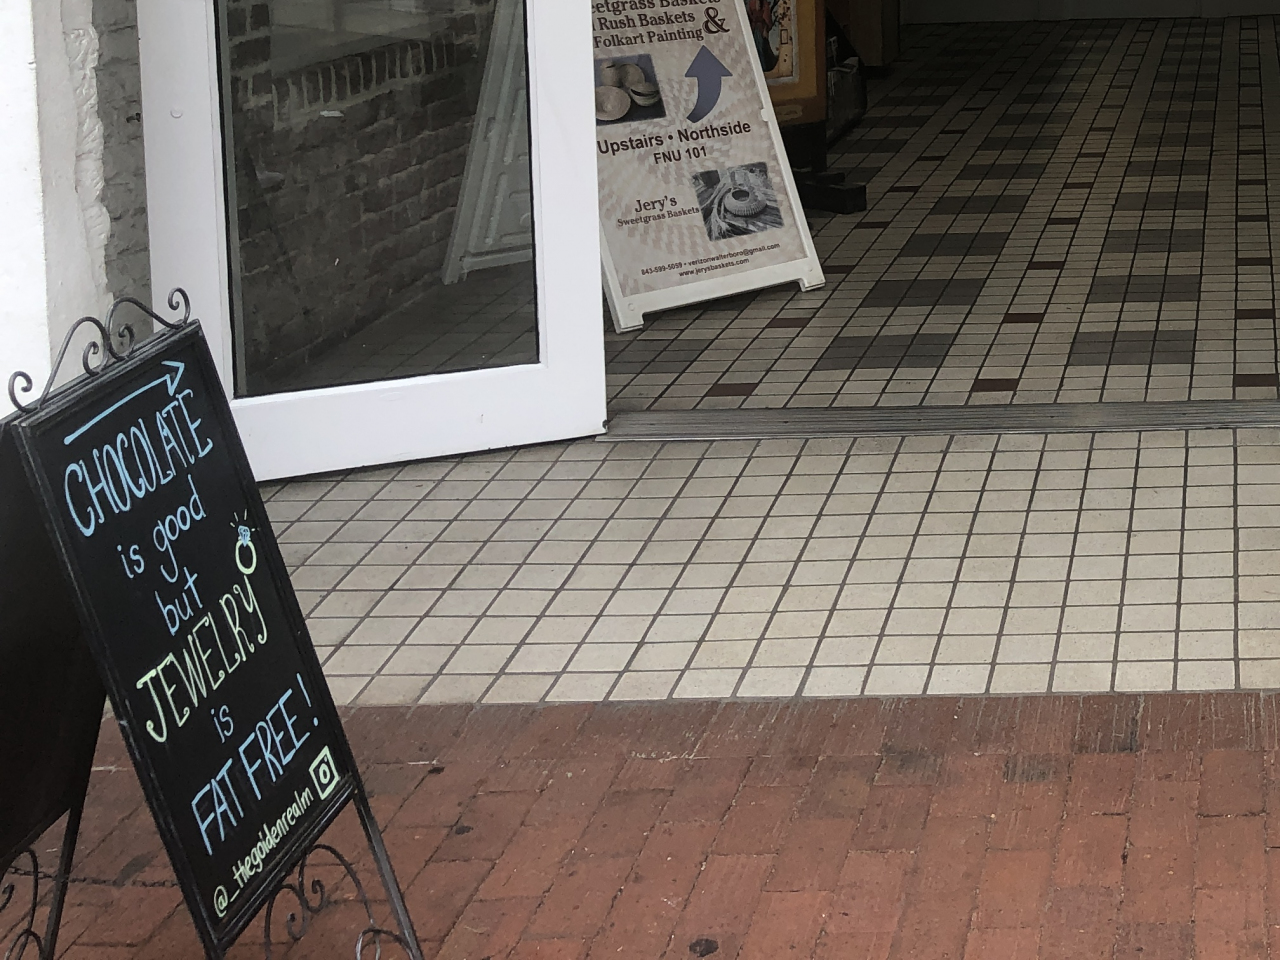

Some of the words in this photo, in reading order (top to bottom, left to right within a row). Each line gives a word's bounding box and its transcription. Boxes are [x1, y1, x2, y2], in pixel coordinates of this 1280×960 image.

[597, 15, 636, 31] Rush
[637, 10, 696, 27] Baskets
[702, 6, 731, 34] &
[593, 33, 646, 49] Folkart
[647, 28, 704, 42] Painting
[596, 133, 664, 155] Upstairs
[677, 120, 752, 143] Northside
[653, 149, 682, 164] FNU
[685, 145, 707, 160] 101
[617, 212, 667, 228] Sweetgrass
[667, 206, 700, 219] Baskets
[635, 195, 678, 213] Jery's
[63, 388, 213, 537] CHOCOLATE
[120, 543, 146, 580] is
[153, 474, 207, 584] good
[157, 566, 204, 636] but
[135, 574, 267, 743] JEWELRY
[210, 708, 234, 744] is
[191, 757, 244, 856] FAT
[238, 672, 320, 801] FREE!
